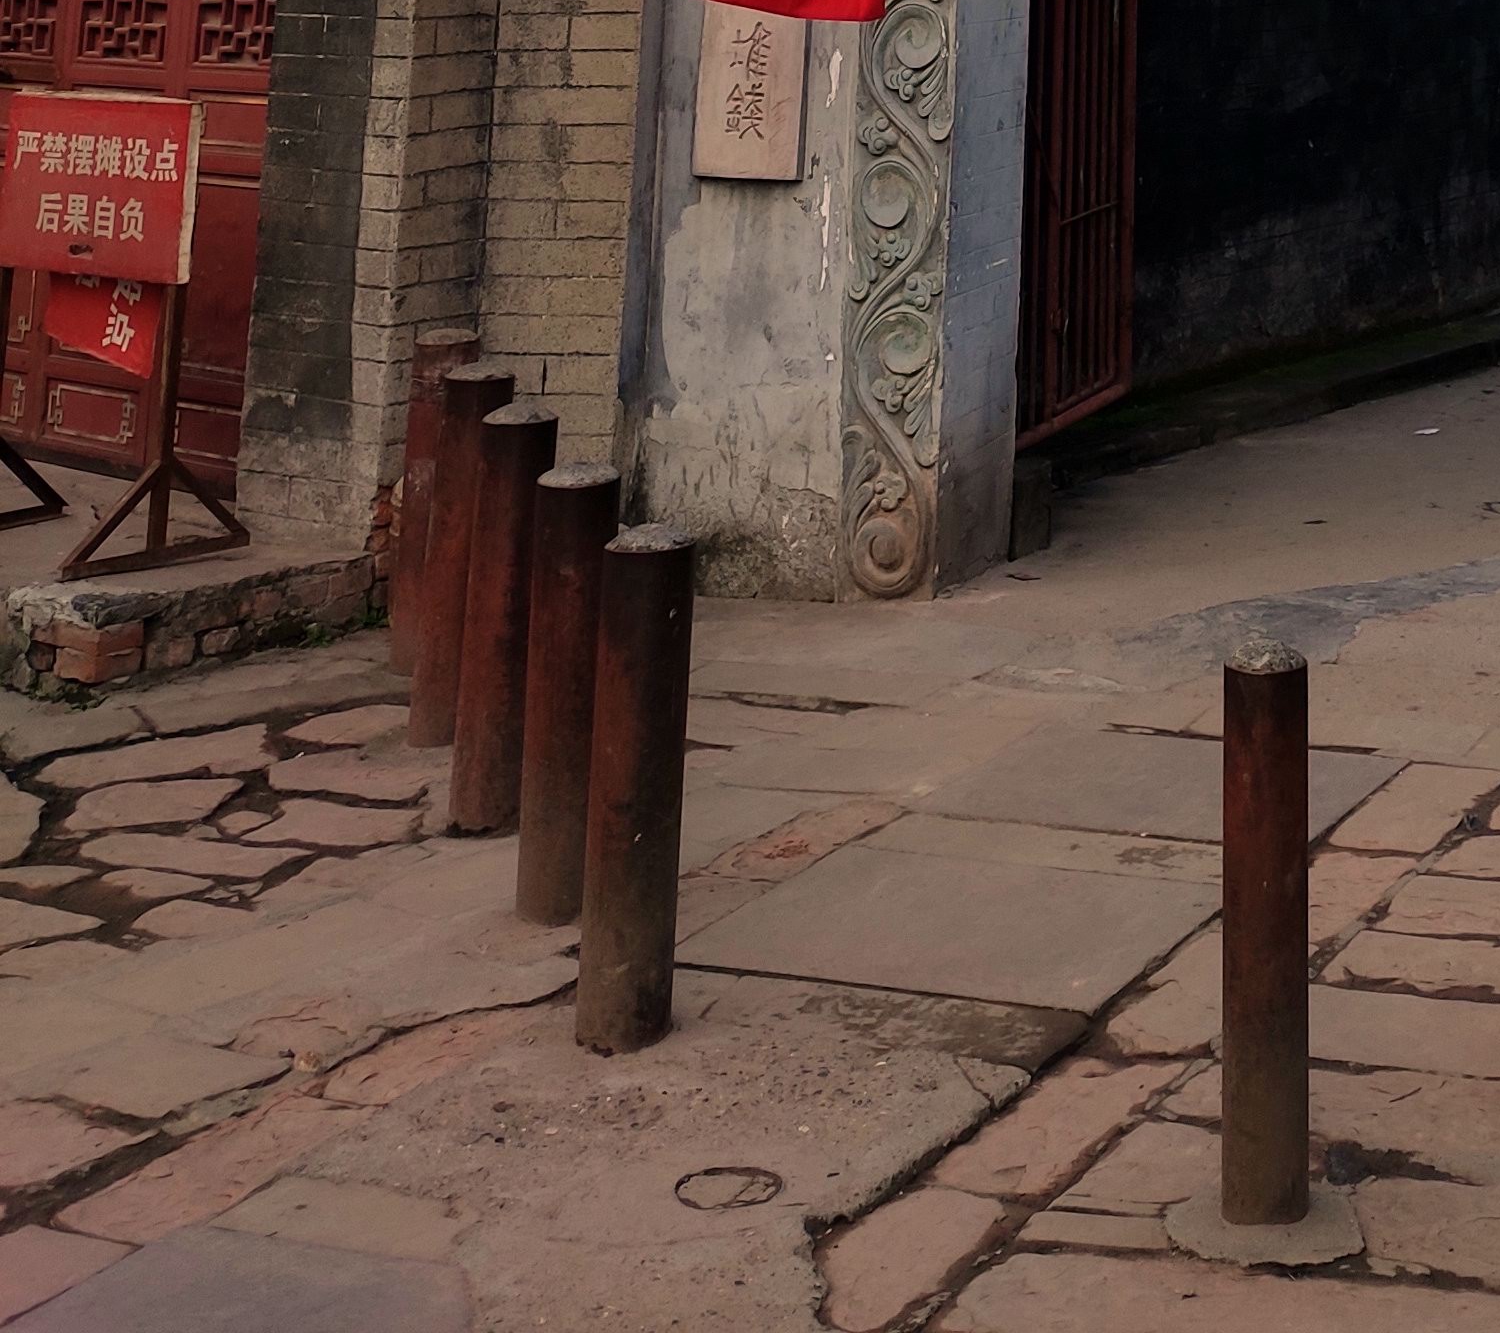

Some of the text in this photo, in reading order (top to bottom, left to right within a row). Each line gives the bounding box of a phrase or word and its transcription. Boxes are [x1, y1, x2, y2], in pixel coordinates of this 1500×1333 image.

[13, 130, 179, 182] 严禁摆摊设点
[35, 192, 145, 242] 后果自负
